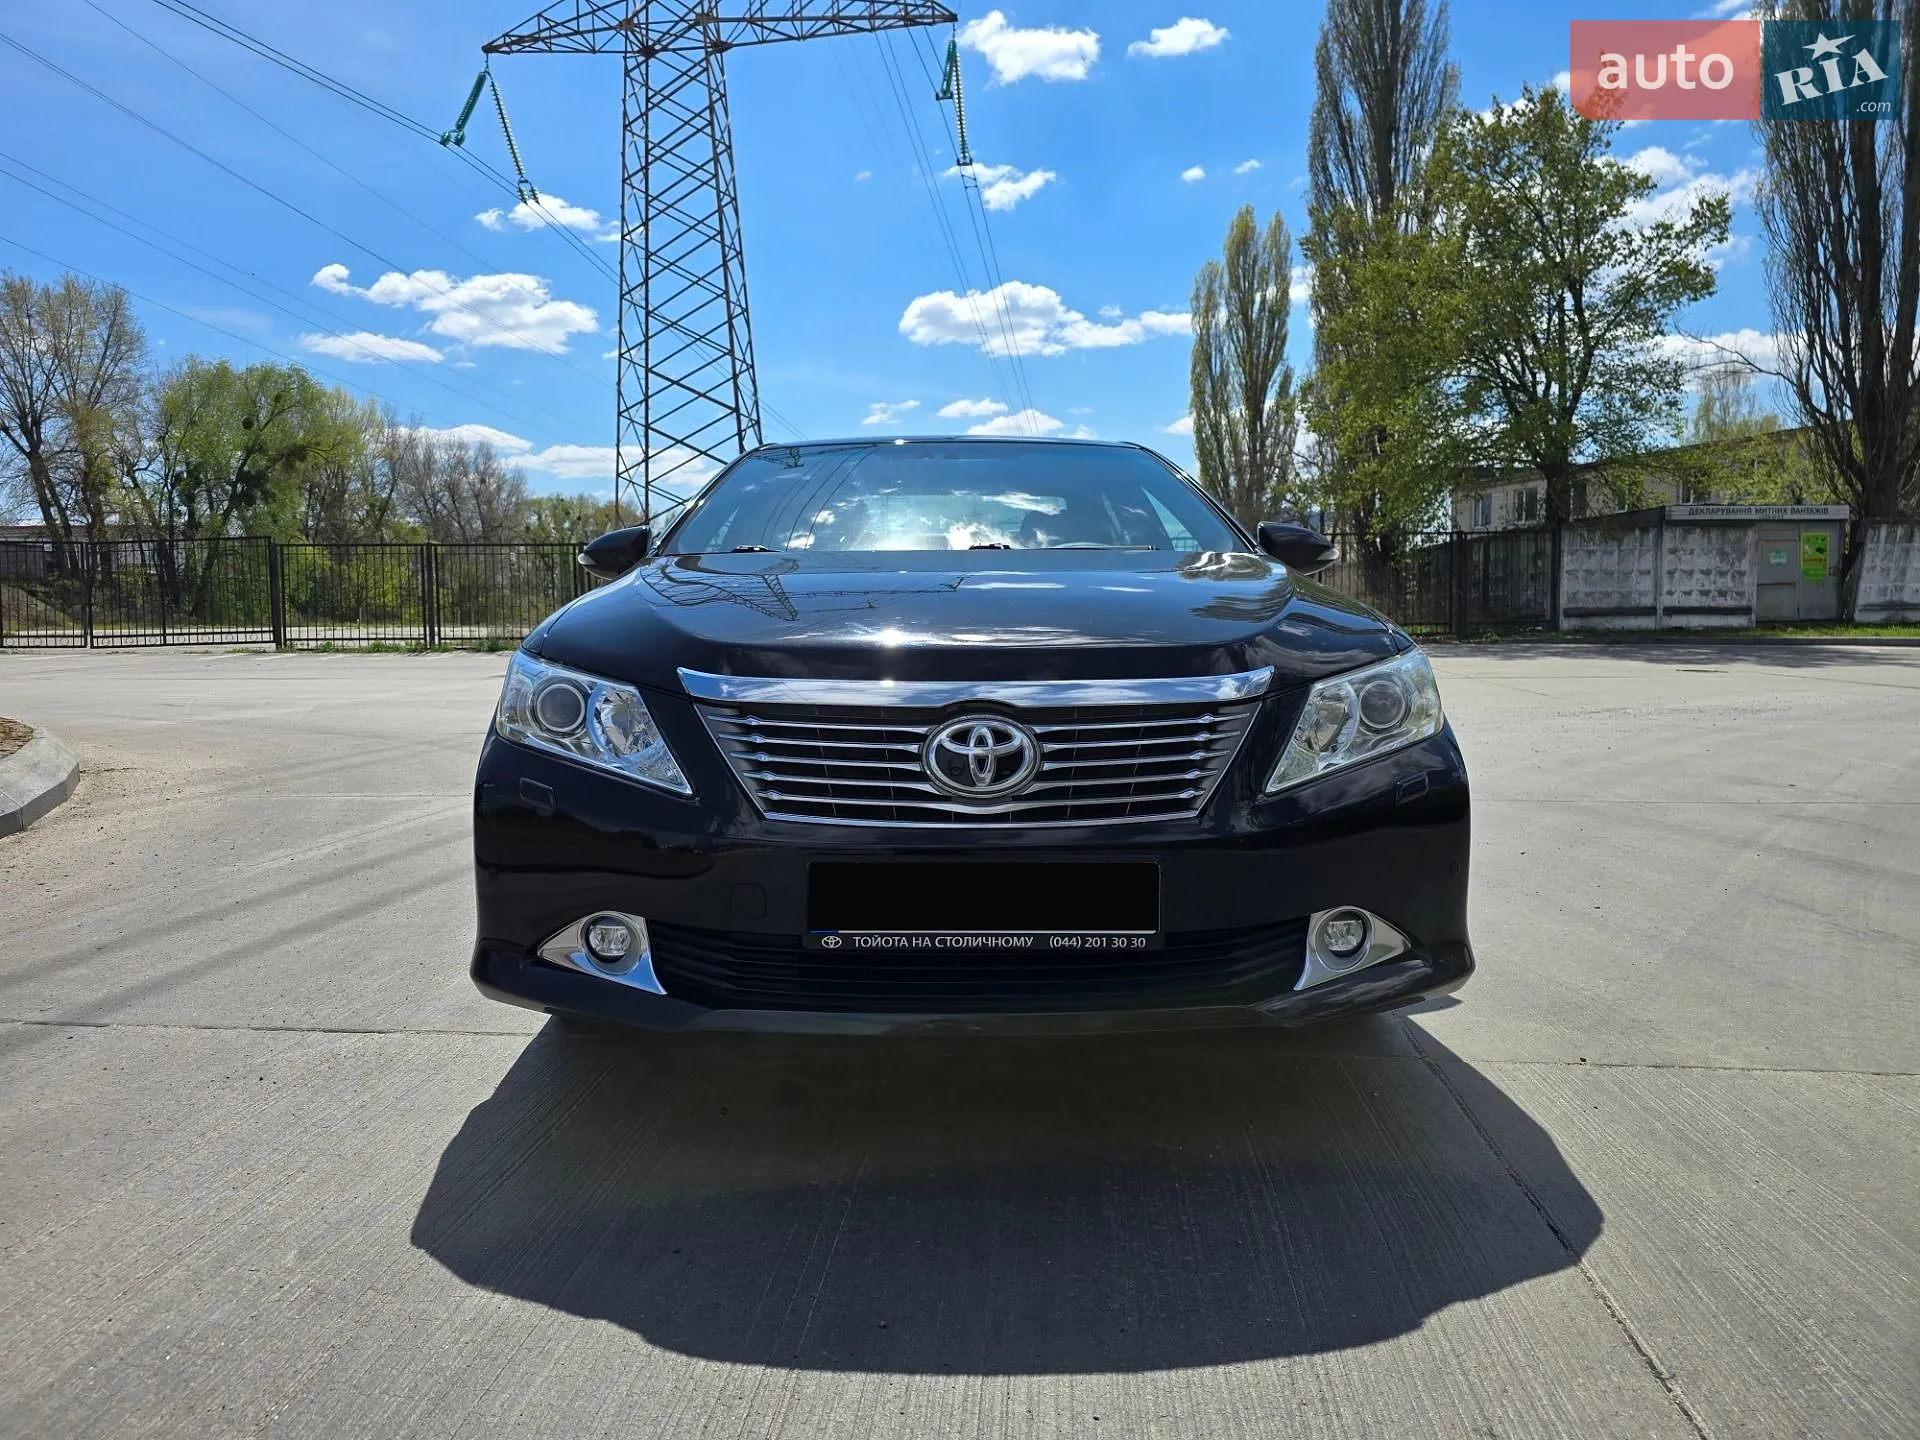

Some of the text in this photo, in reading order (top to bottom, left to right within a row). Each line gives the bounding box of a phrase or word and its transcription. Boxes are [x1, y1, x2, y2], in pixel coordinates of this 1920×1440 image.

[1688, 507, 1829, 516] ДЕКЛАРУВАННЯ МИТНИХ ВАНТАЖІВ
[852, 934, 1146, 949] ТОЙОТА НА СТОЛИЧНОМУ (044) 201 30 30
